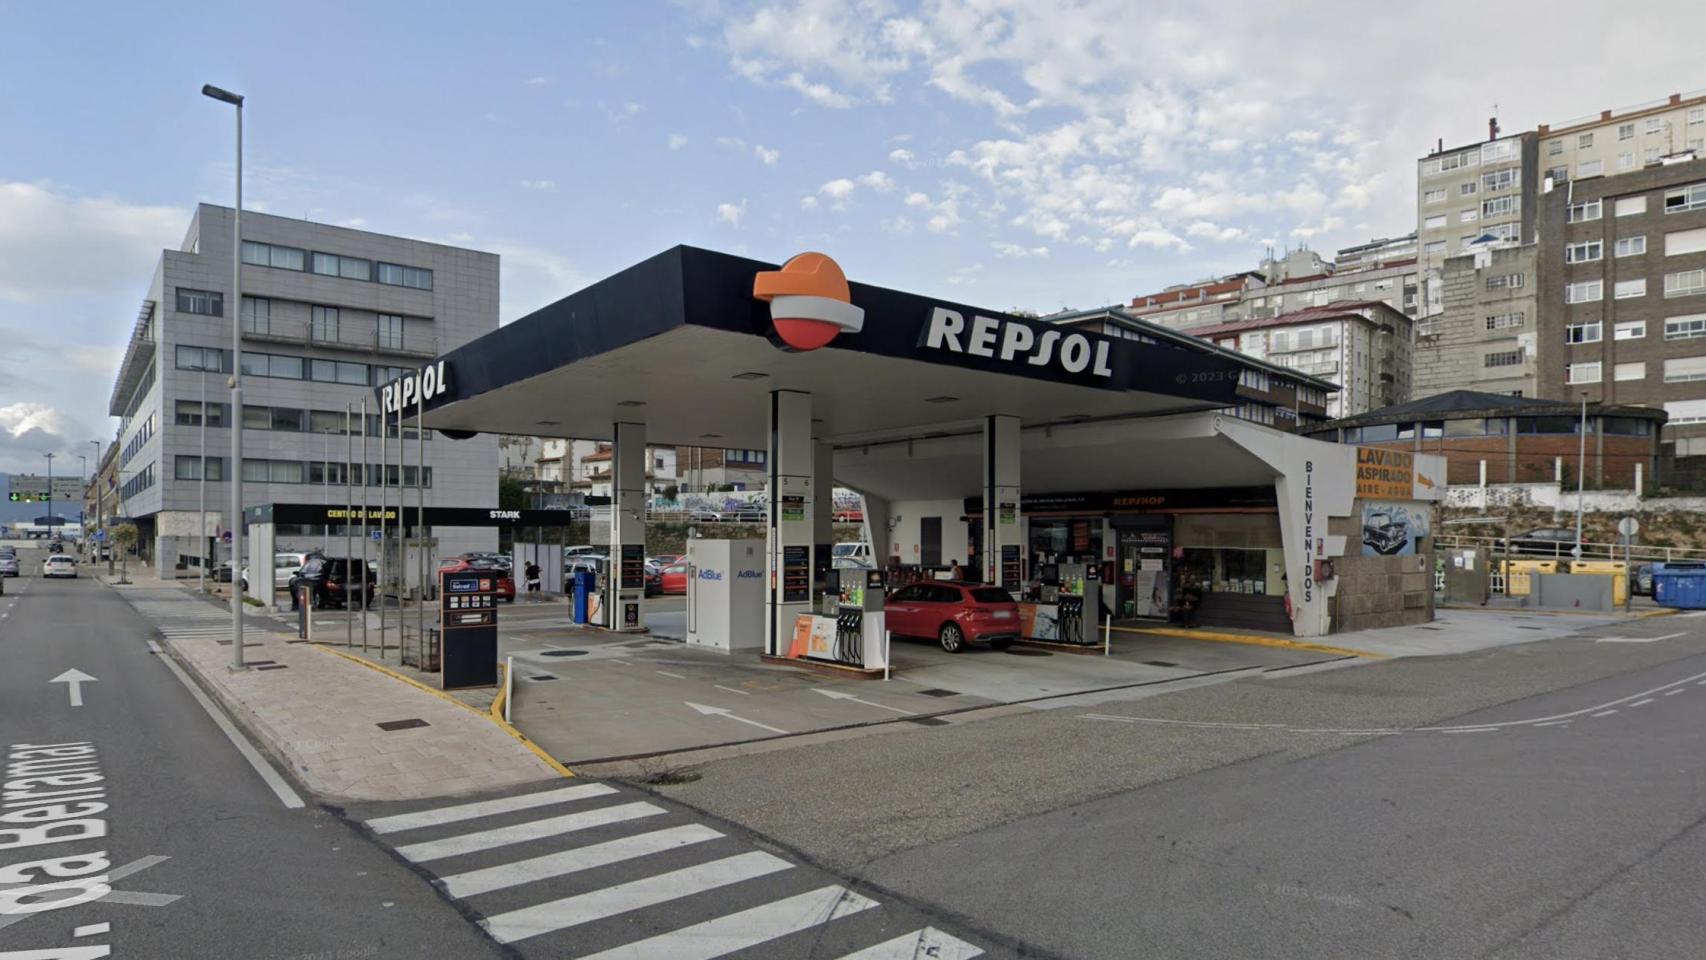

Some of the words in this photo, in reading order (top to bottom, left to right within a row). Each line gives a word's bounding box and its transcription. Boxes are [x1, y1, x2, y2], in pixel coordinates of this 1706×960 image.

[926, 306, 1114, 378] REPSOL
[1357, 448, 1412, 468] LAVADO
[1357, 466, 1411, 484] ASPIRADO
[1357, 484, 1380, 495] AIRE
[327, 510, 357, 518] CENTO
[368, 510, 396, 519] LAVDO
[489, 510, 520, 519] STARK
[1304, 460, 1313, 602] BIENVENIDOS
[698, 569, 722, 581] AdBlue
[737, 569, 762, 578] AdBlue
